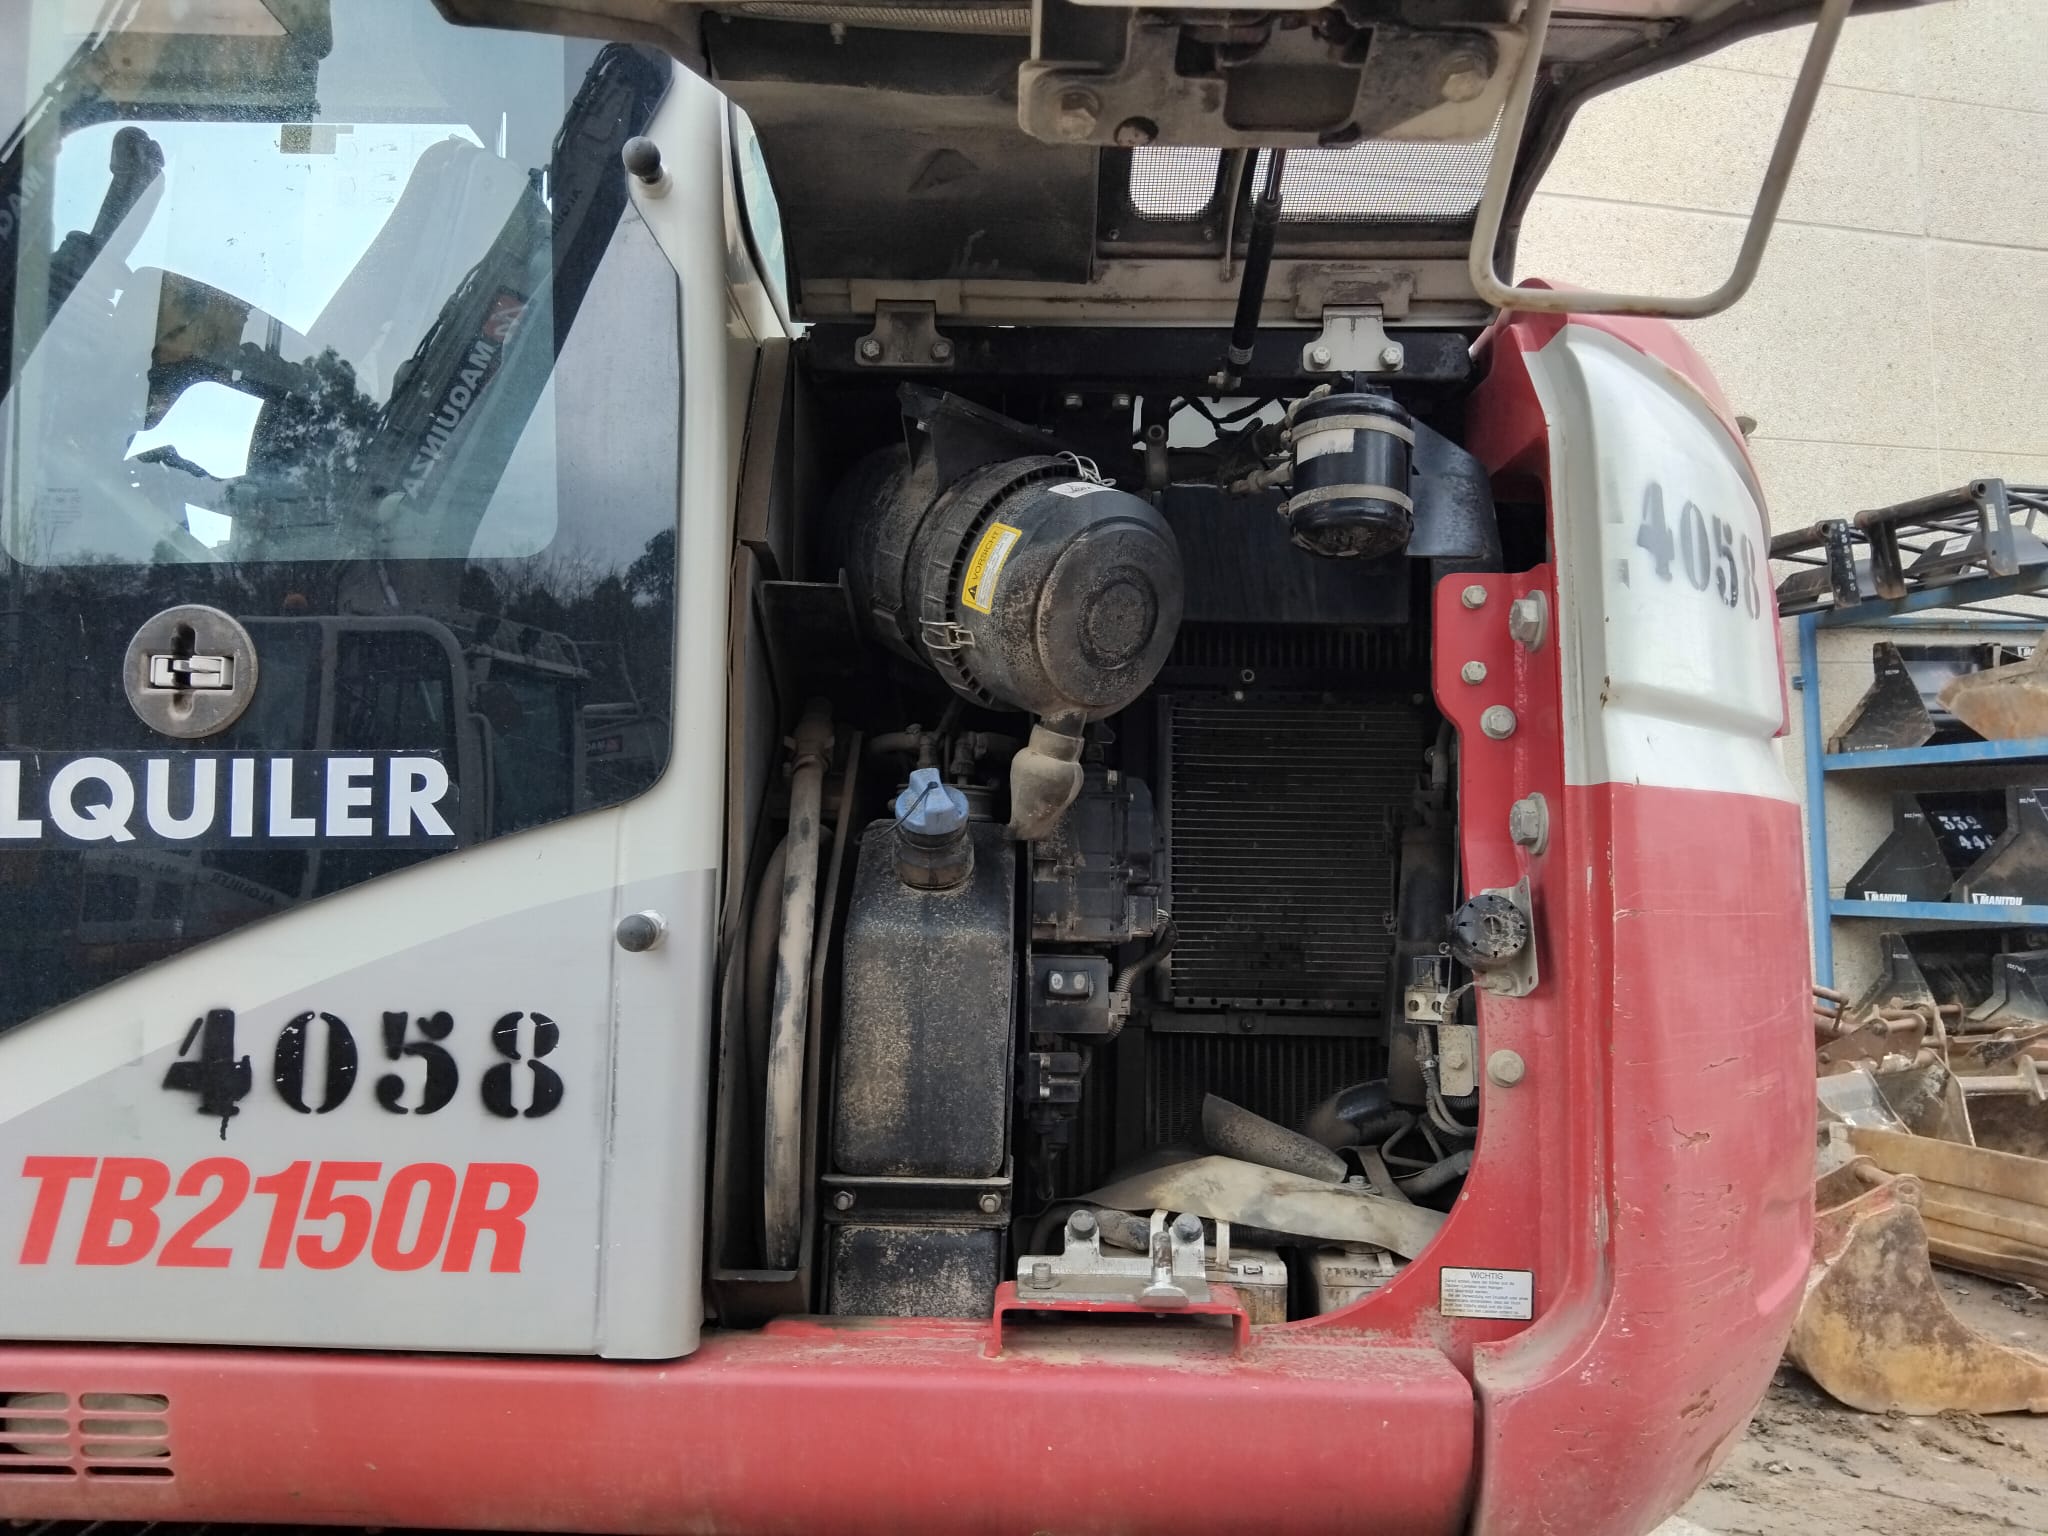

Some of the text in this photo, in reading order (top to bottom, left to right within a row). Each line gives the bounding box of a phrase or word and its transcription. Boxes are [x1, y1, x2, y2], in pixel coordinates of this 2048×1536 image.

[972, 530, 1000, 579] VORSICHT
[1636, 480, 1761, 620] 4058
[1973, 894, 2023, 905] MANITOU
[161, 1008, 565, 1118] 4058
[19, 1155, 540, 1273] TB2150R
[1469, 1271, 1504, 1280] WICHTIG
